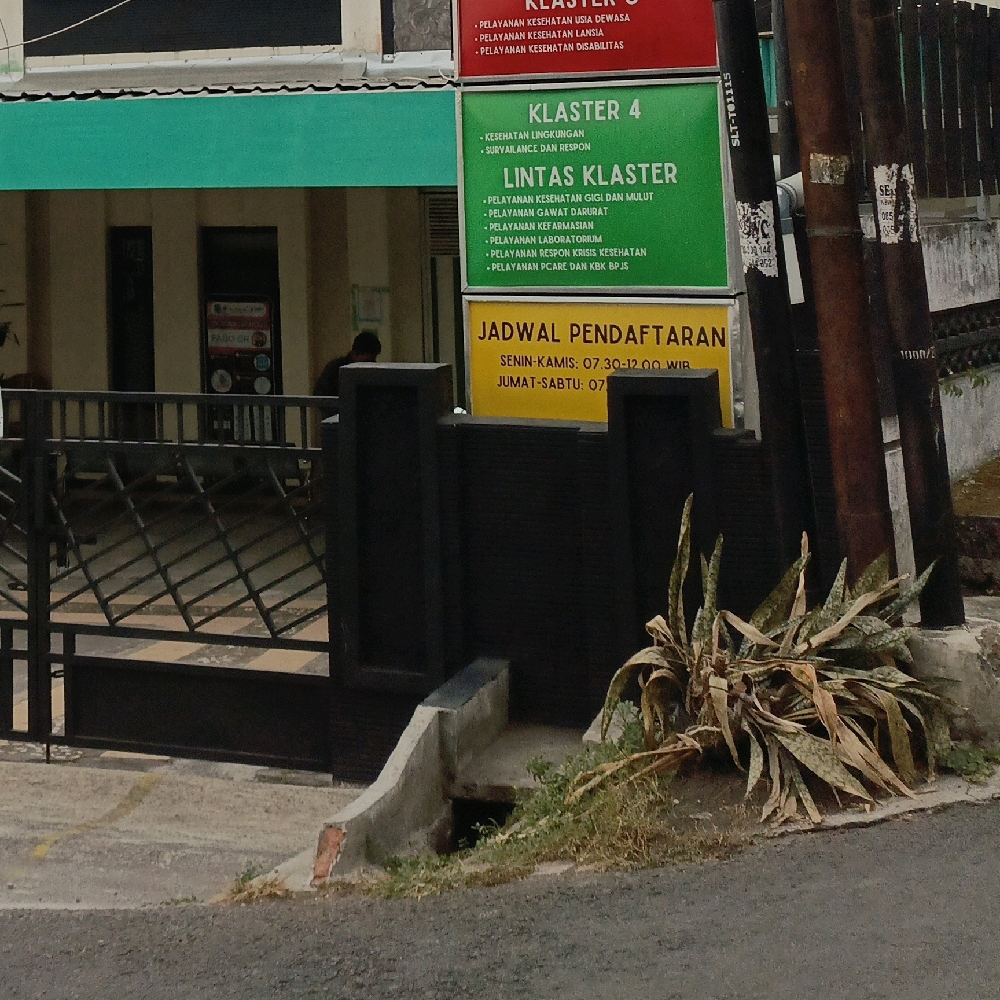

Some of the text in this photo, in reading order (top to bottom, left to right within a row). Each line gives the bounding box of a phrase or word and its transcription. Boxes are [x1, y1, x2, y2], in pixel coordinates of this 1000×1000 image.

[480, 14, 630, 28] PELAYANAN KESEHATAN USIA DEWASA
[480, 28, 604, 42] PELAYANAN KESEHATAN LANSIA
[480, 41, 624, 55] PELAYANAN KESEHATAN DISABILITAS
[530, 99, 641, 123] KLASTER 4
[485, 130, 584, 141] KESEHATAN LINGKUNGAN
[541, 144, 557, 152] DAN
[560, 143, 590, 151] RESPON
[504, 163, 677, 188] LINTAS KLASTER
[488, 195, 534, 204] PELAYANAN
[536, 194, 582, 203] KESEHATAN
[606, 193, 623, 201] DAN
[626, 192, 653, 201] MULUT
[489, 207, 608, 218] PELAYANAN GAWAT DARURAT
[490, 221, 593, 231] PELAYANAN KEFARMASIAN
[490, 235, 602, 244] PELAYANAN LABORATORIUM
[491, 249, 537, 258] PELAYANAN
[539, 249, 570, 257] RESPON
[599, 248, 646, 256] KESEHATAN
[492, 263, 538, 271] PELAYANAN
[541, 262, 567, 270] PCARE
[590, 262, 606, 270] KBK
[609, 262, 628, 270] BPJS
[478, 322, 725, 347] JADWAL PENDAFTARAN
[500, 354, 579, 370] SENIN-KAMIS:
[497, 376, 584, 391] JUMAT-SABTU:
